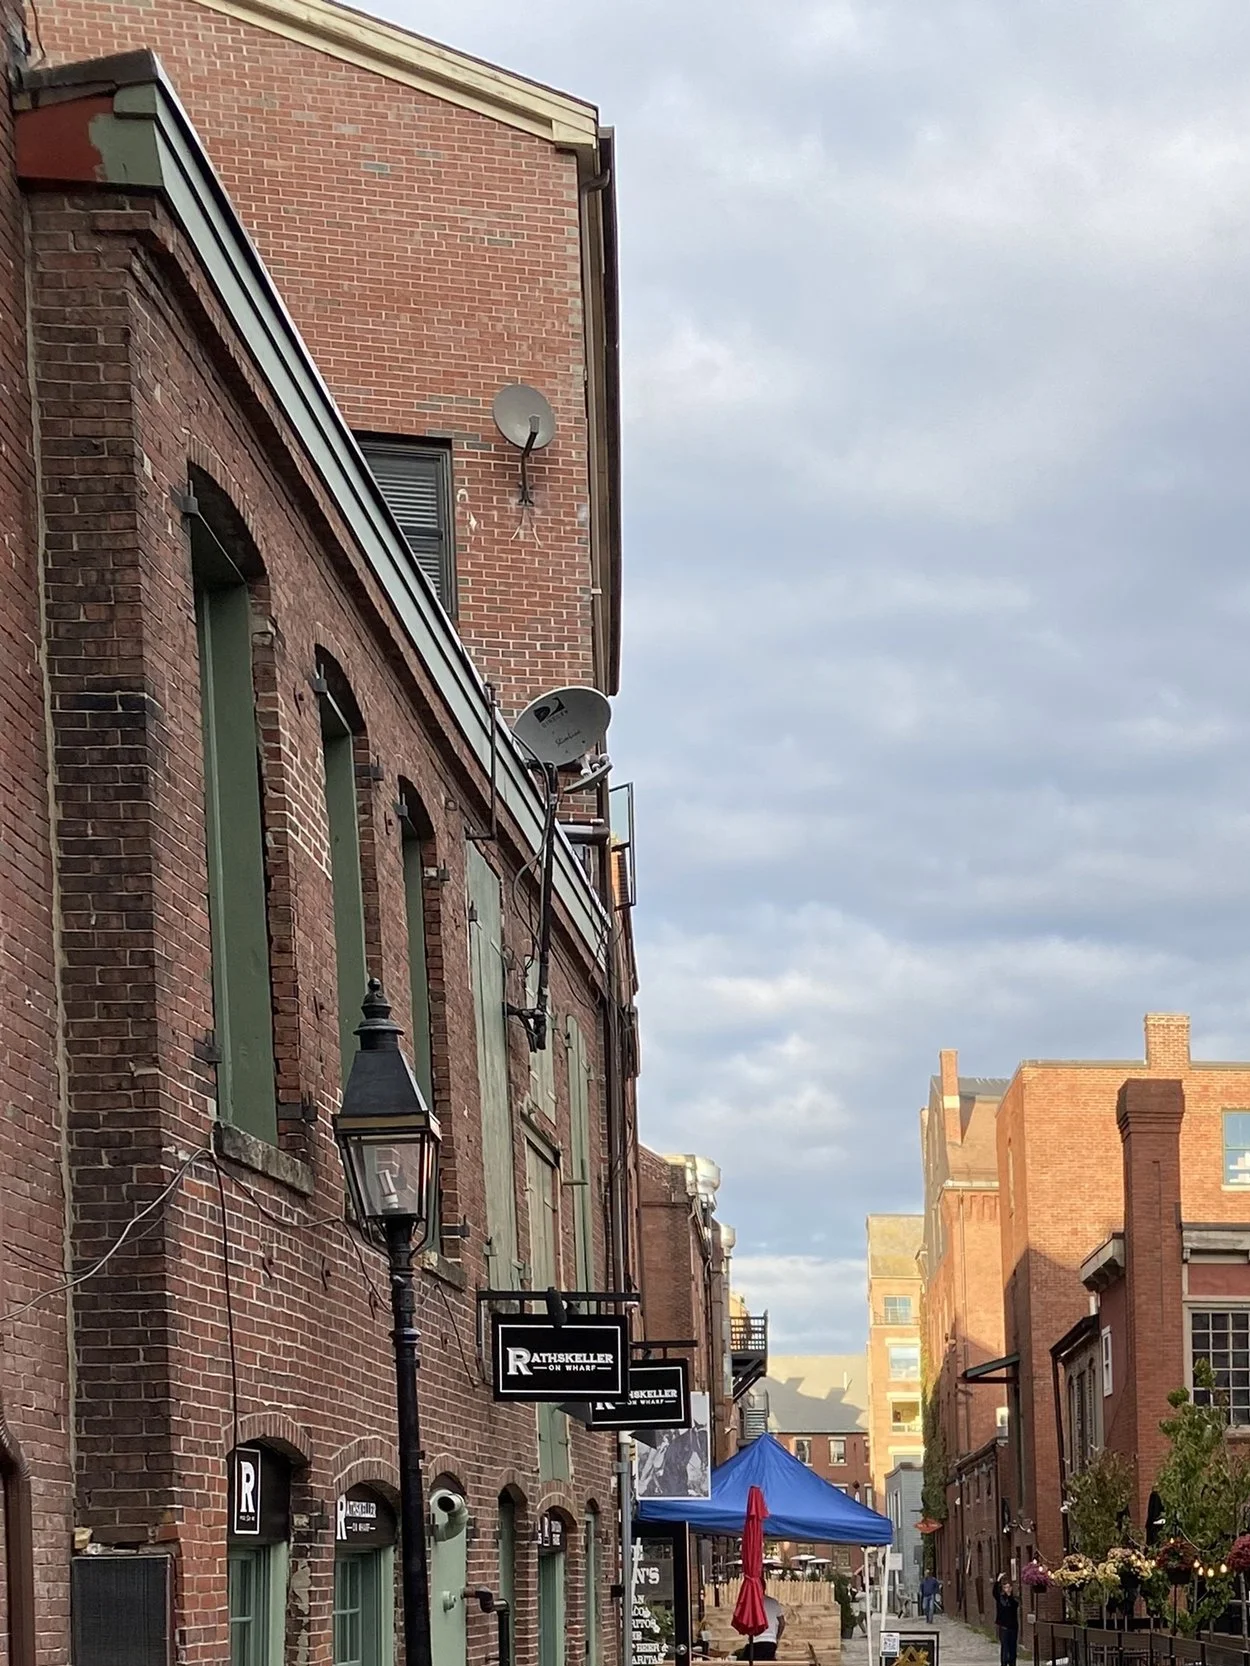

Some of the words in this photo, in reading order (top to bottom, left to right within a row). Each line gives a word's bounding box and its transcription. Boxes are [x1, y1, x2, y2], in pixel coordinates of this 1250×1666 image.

[507, 1347, 614, 1376] RATHSKELLER
[548, 1364, 562, 1372] ON
[565, 1364, 597, 1372] WHARF
[239, 1461, 256, 1513] R
